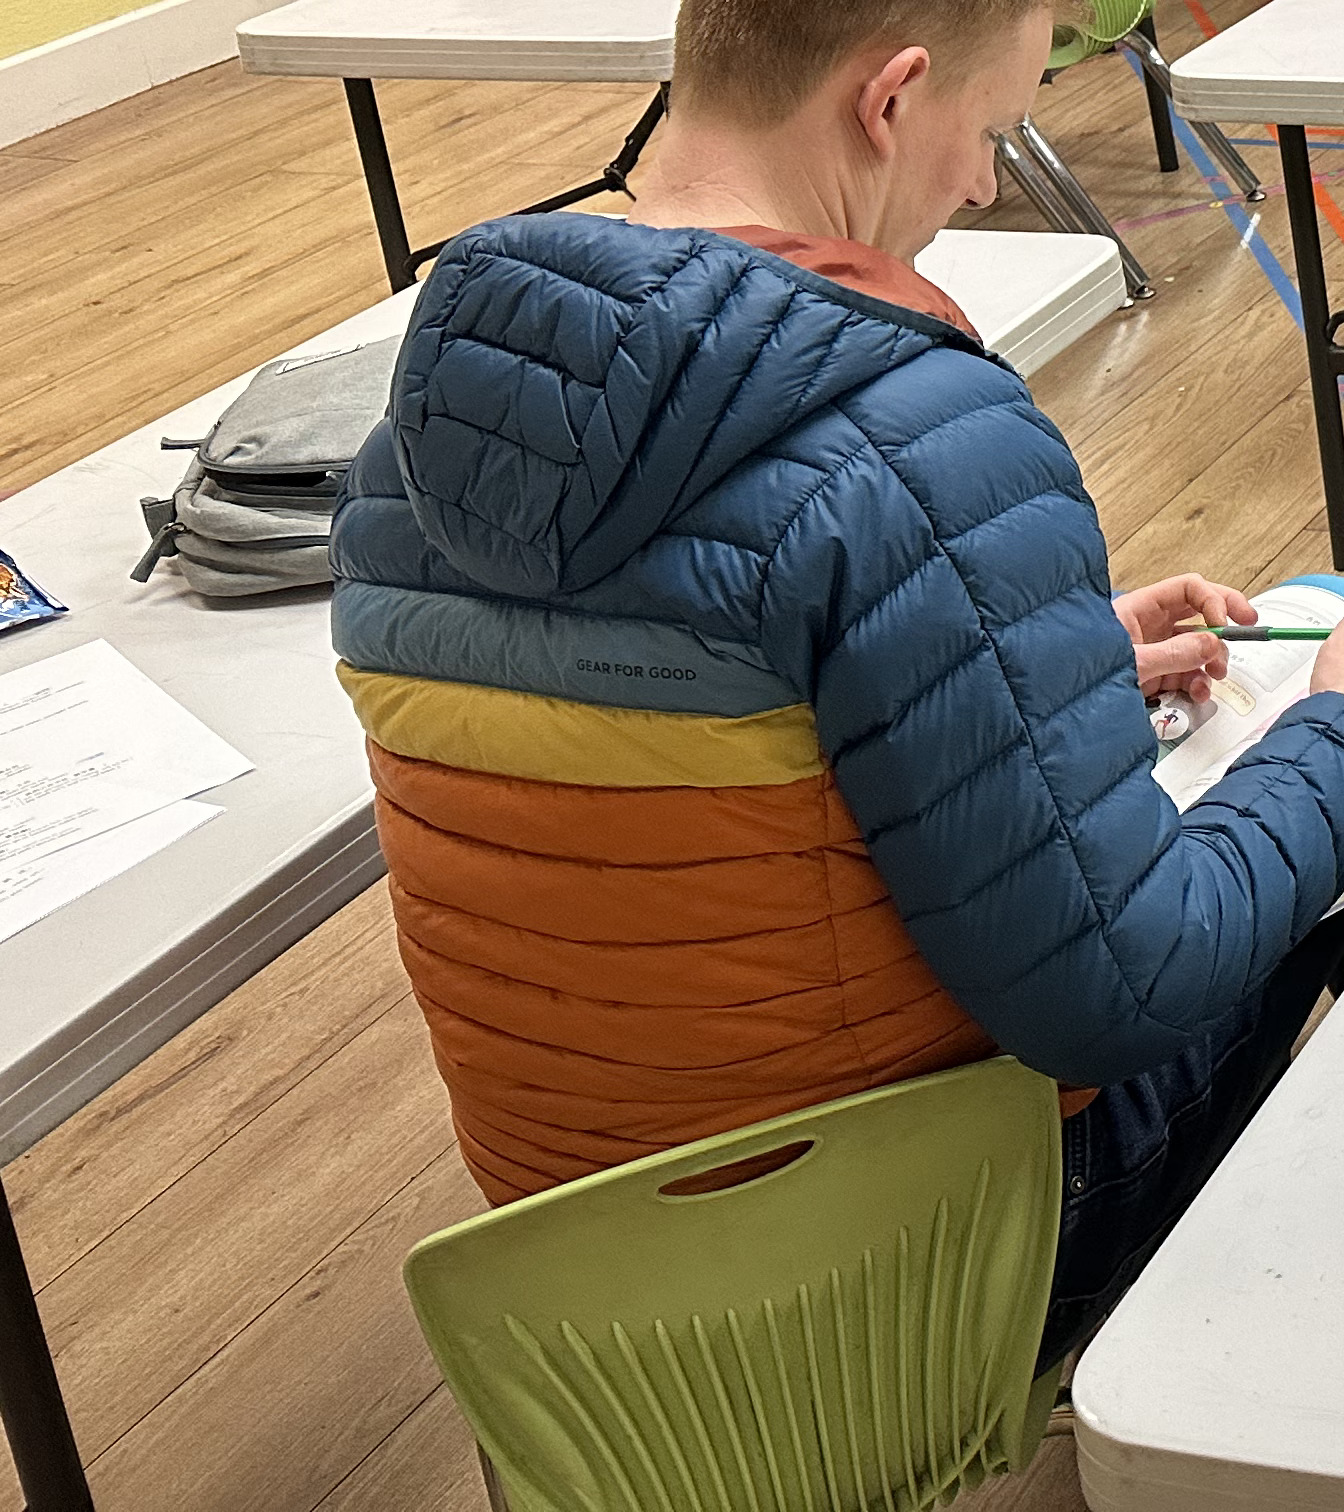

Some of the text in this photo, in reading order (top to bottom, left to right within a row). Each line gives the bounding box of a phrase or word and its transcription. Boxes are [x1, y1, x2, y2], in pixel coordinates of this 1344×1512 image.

[577, 659, 697, 681] GEAR FOR GOOD
